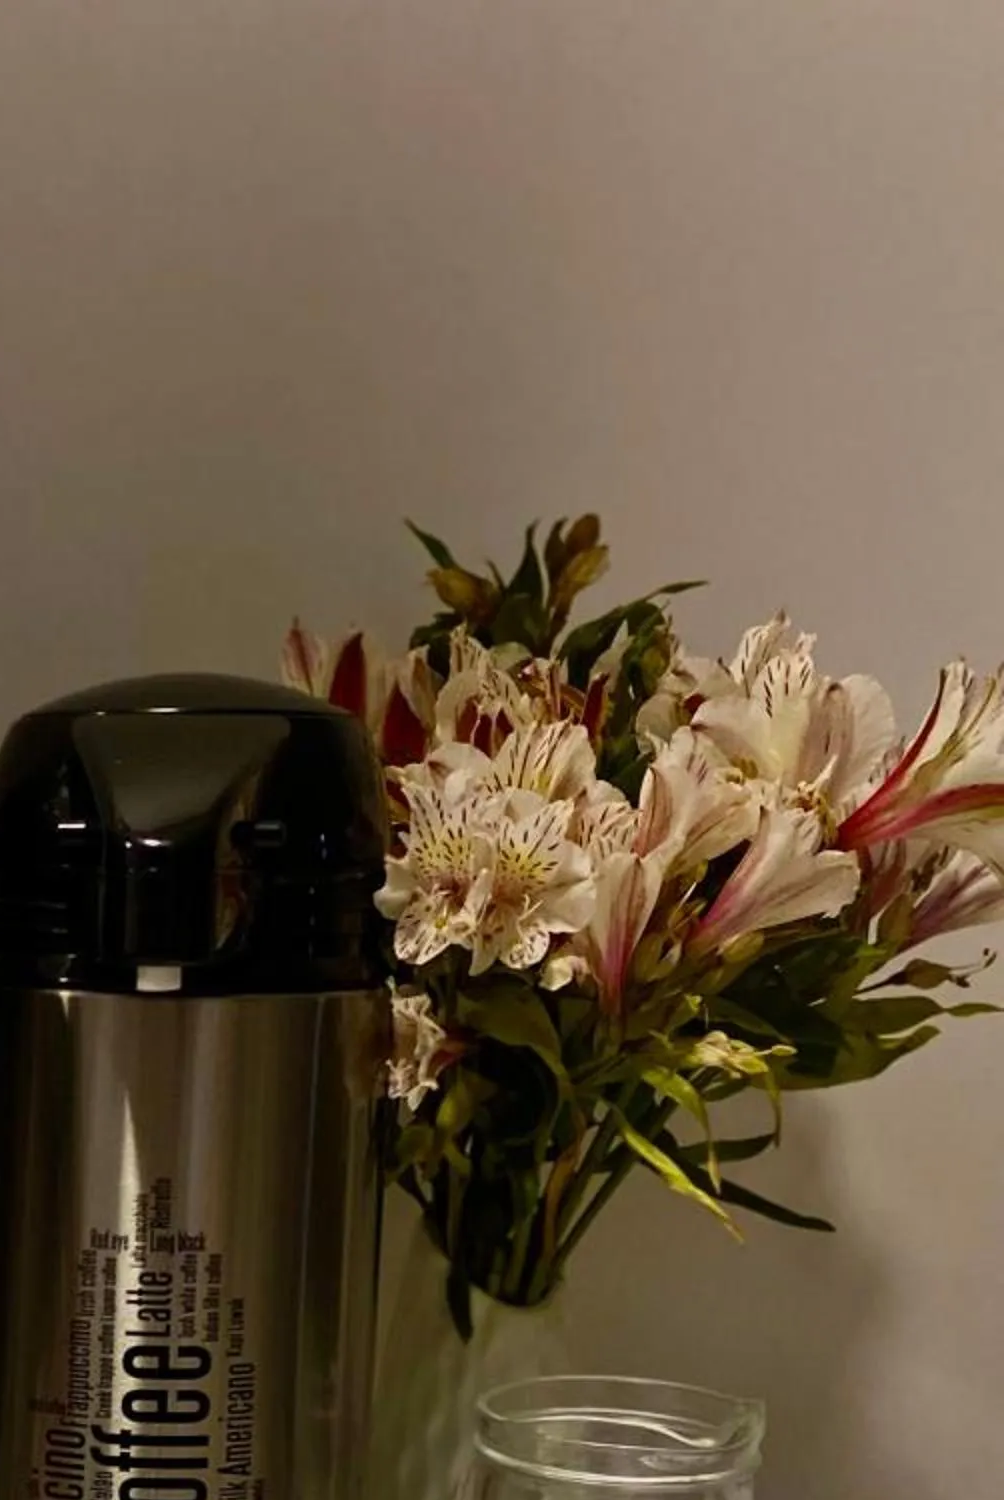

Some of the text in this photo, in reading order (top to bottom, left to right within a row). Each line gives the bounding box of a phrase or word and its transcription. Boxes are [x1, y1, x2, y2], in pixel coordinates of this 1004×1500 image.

[125, 1271, 174, 1338] Latte
[60, 1319, 94, 1428] Frappuccino
[217, 1362, 256, 1476] Americano
